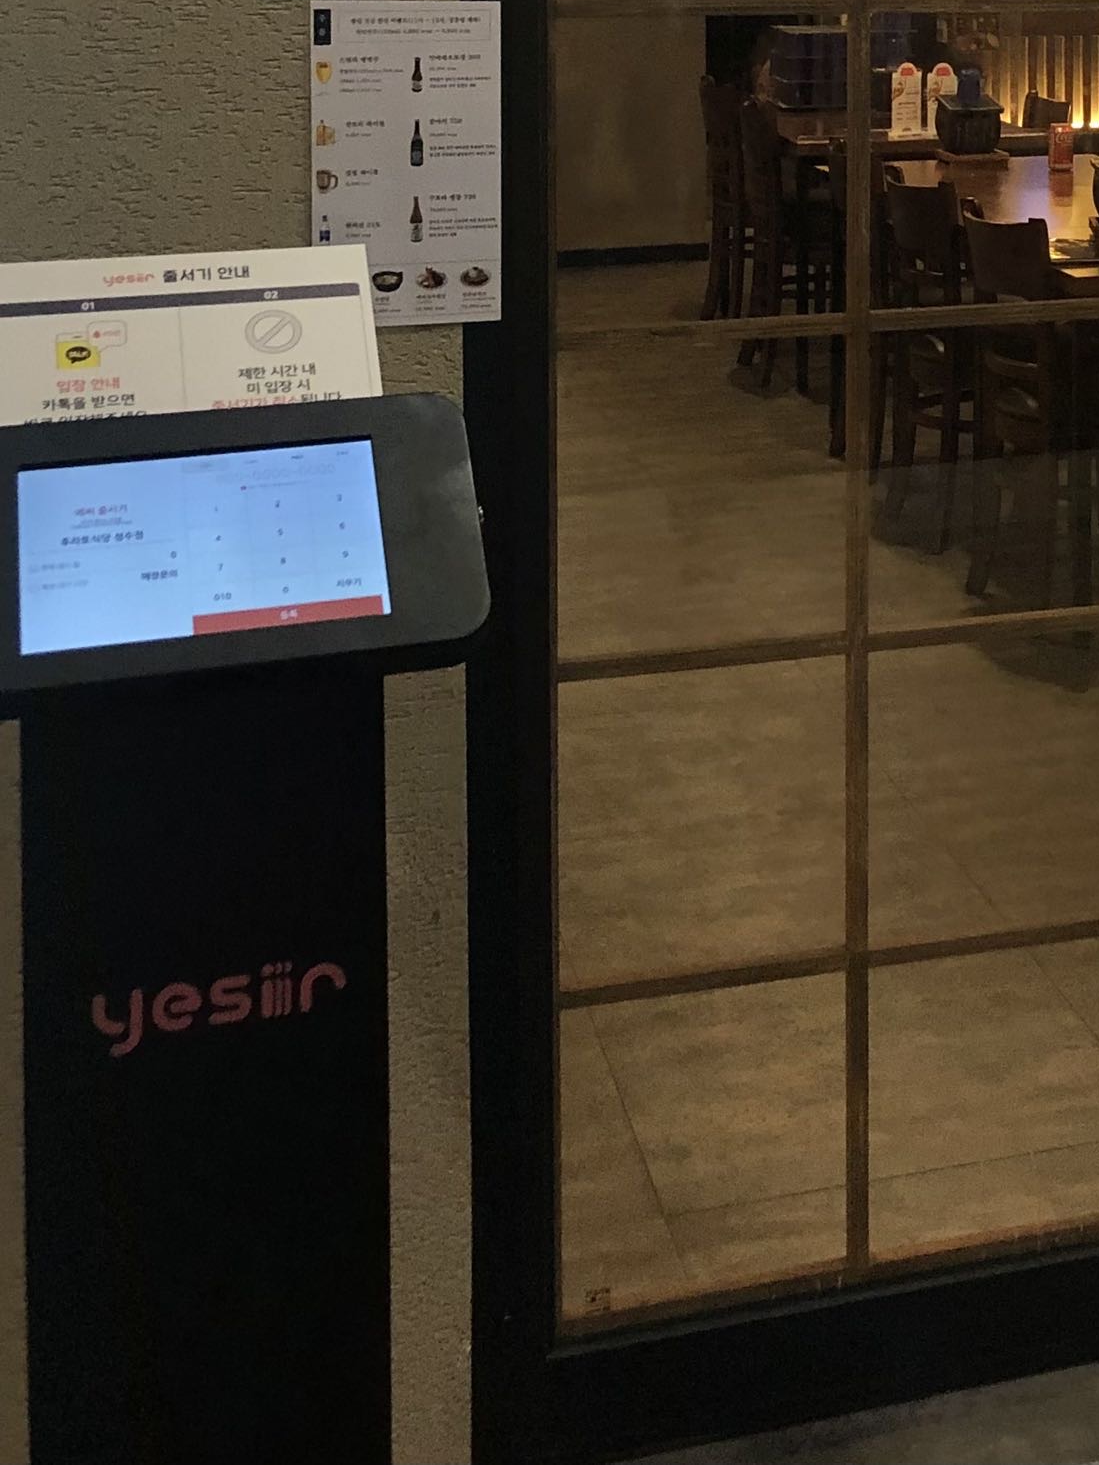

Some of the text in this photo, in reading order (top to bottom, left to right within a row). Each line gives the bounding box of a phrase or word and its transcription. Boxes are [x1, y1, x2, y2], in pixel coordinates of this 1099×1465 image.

[163, 267, 211, 283] 줄서기
[217, 265, 250, 280] 안내
[263, 290, 279, 300] 02
[81, 301, 95, 311] 01
[238, 362, 316, 379] 제한 시간 내
[247, 379, 311, 394] 미 입장 시
[42, 393, 135, 411] 카톡을 받으면
[170, 550, 177, 559] 0
